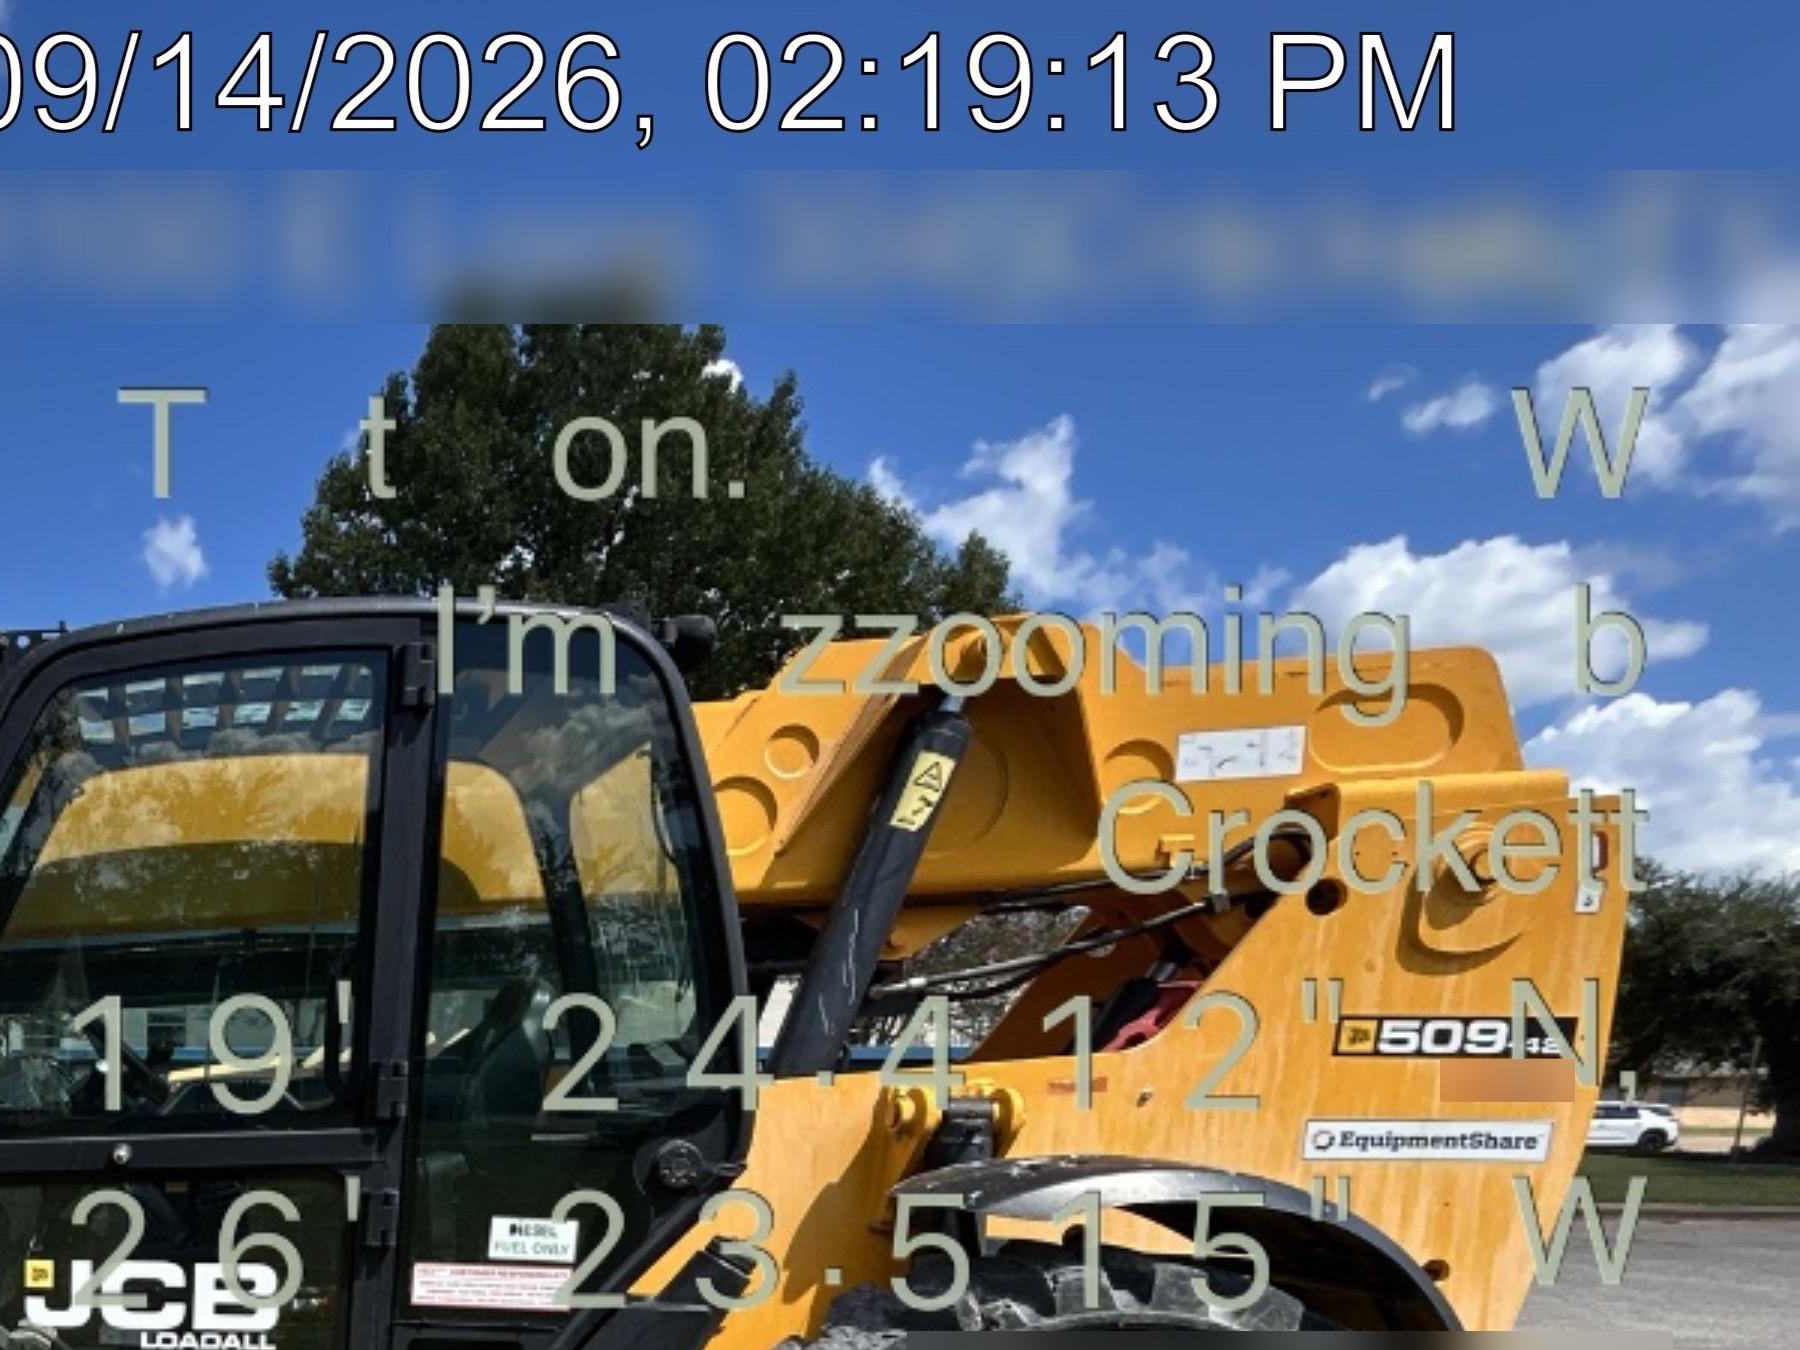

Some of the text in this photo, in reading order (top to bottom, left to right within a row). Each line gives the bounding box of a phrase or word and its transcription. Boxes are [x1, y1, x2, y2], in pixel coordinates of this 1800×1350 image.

[1339, 1130, 1540, 1151] EquipmentShare
[23, 1259, 281, 1330] JCB
[140, 1331, 277, 1350] LOADALL
